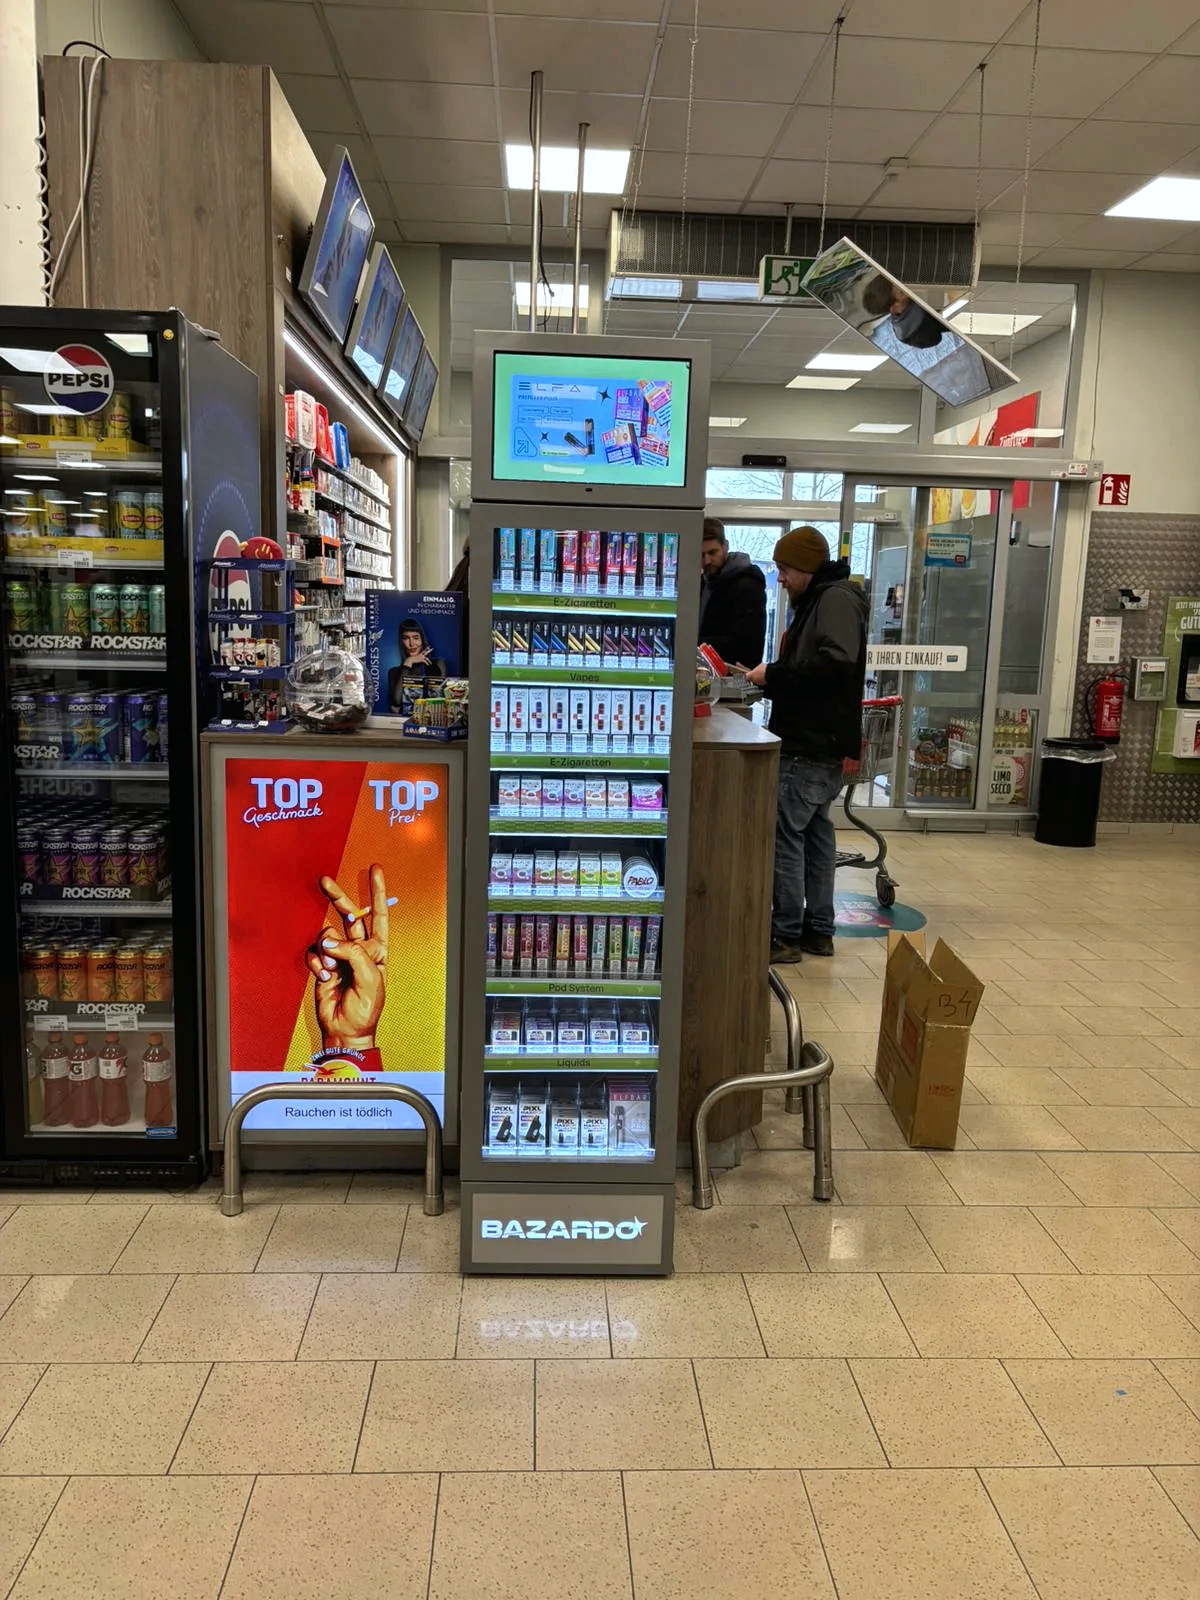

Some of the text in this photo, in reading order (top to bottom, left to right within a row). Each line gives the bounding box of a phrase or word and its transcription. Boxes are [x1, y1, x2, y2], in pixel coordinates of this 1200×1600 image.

[48, 373, 109, 388] PEPSI
[553, 598, 617, 609] E-Zigaretten
[876, 651, 902, 665] IHREN
[905, 651, 943, 666] EINKAUF!
[569, 673, 600, 683] Vapes
[550, 757, 612, 768] E-Zigaretten
[993, 770, 1011, 782] LIMO
[250, 777, 323, 809] TOP
[991, 783, 1011, 794] SECCO
[368, 780, 439, 811] TOP
[243, 806, 323, 828] Geschmack
[628, 876, 654, 886] PABLO
[63, 887, 131, 899] ROCKSTAR
[549, 984, 604, 994] Pod System
[77, 1003, 146, 1014] ROCKSTAR
[938, 990, 972, 1018] B4
[557, 1058, 591, 1068] Liquids
[285, 1106, 393, 1118] Rauchen ist tödlich
[481, 1218, 643, 1240] BAZARDO
